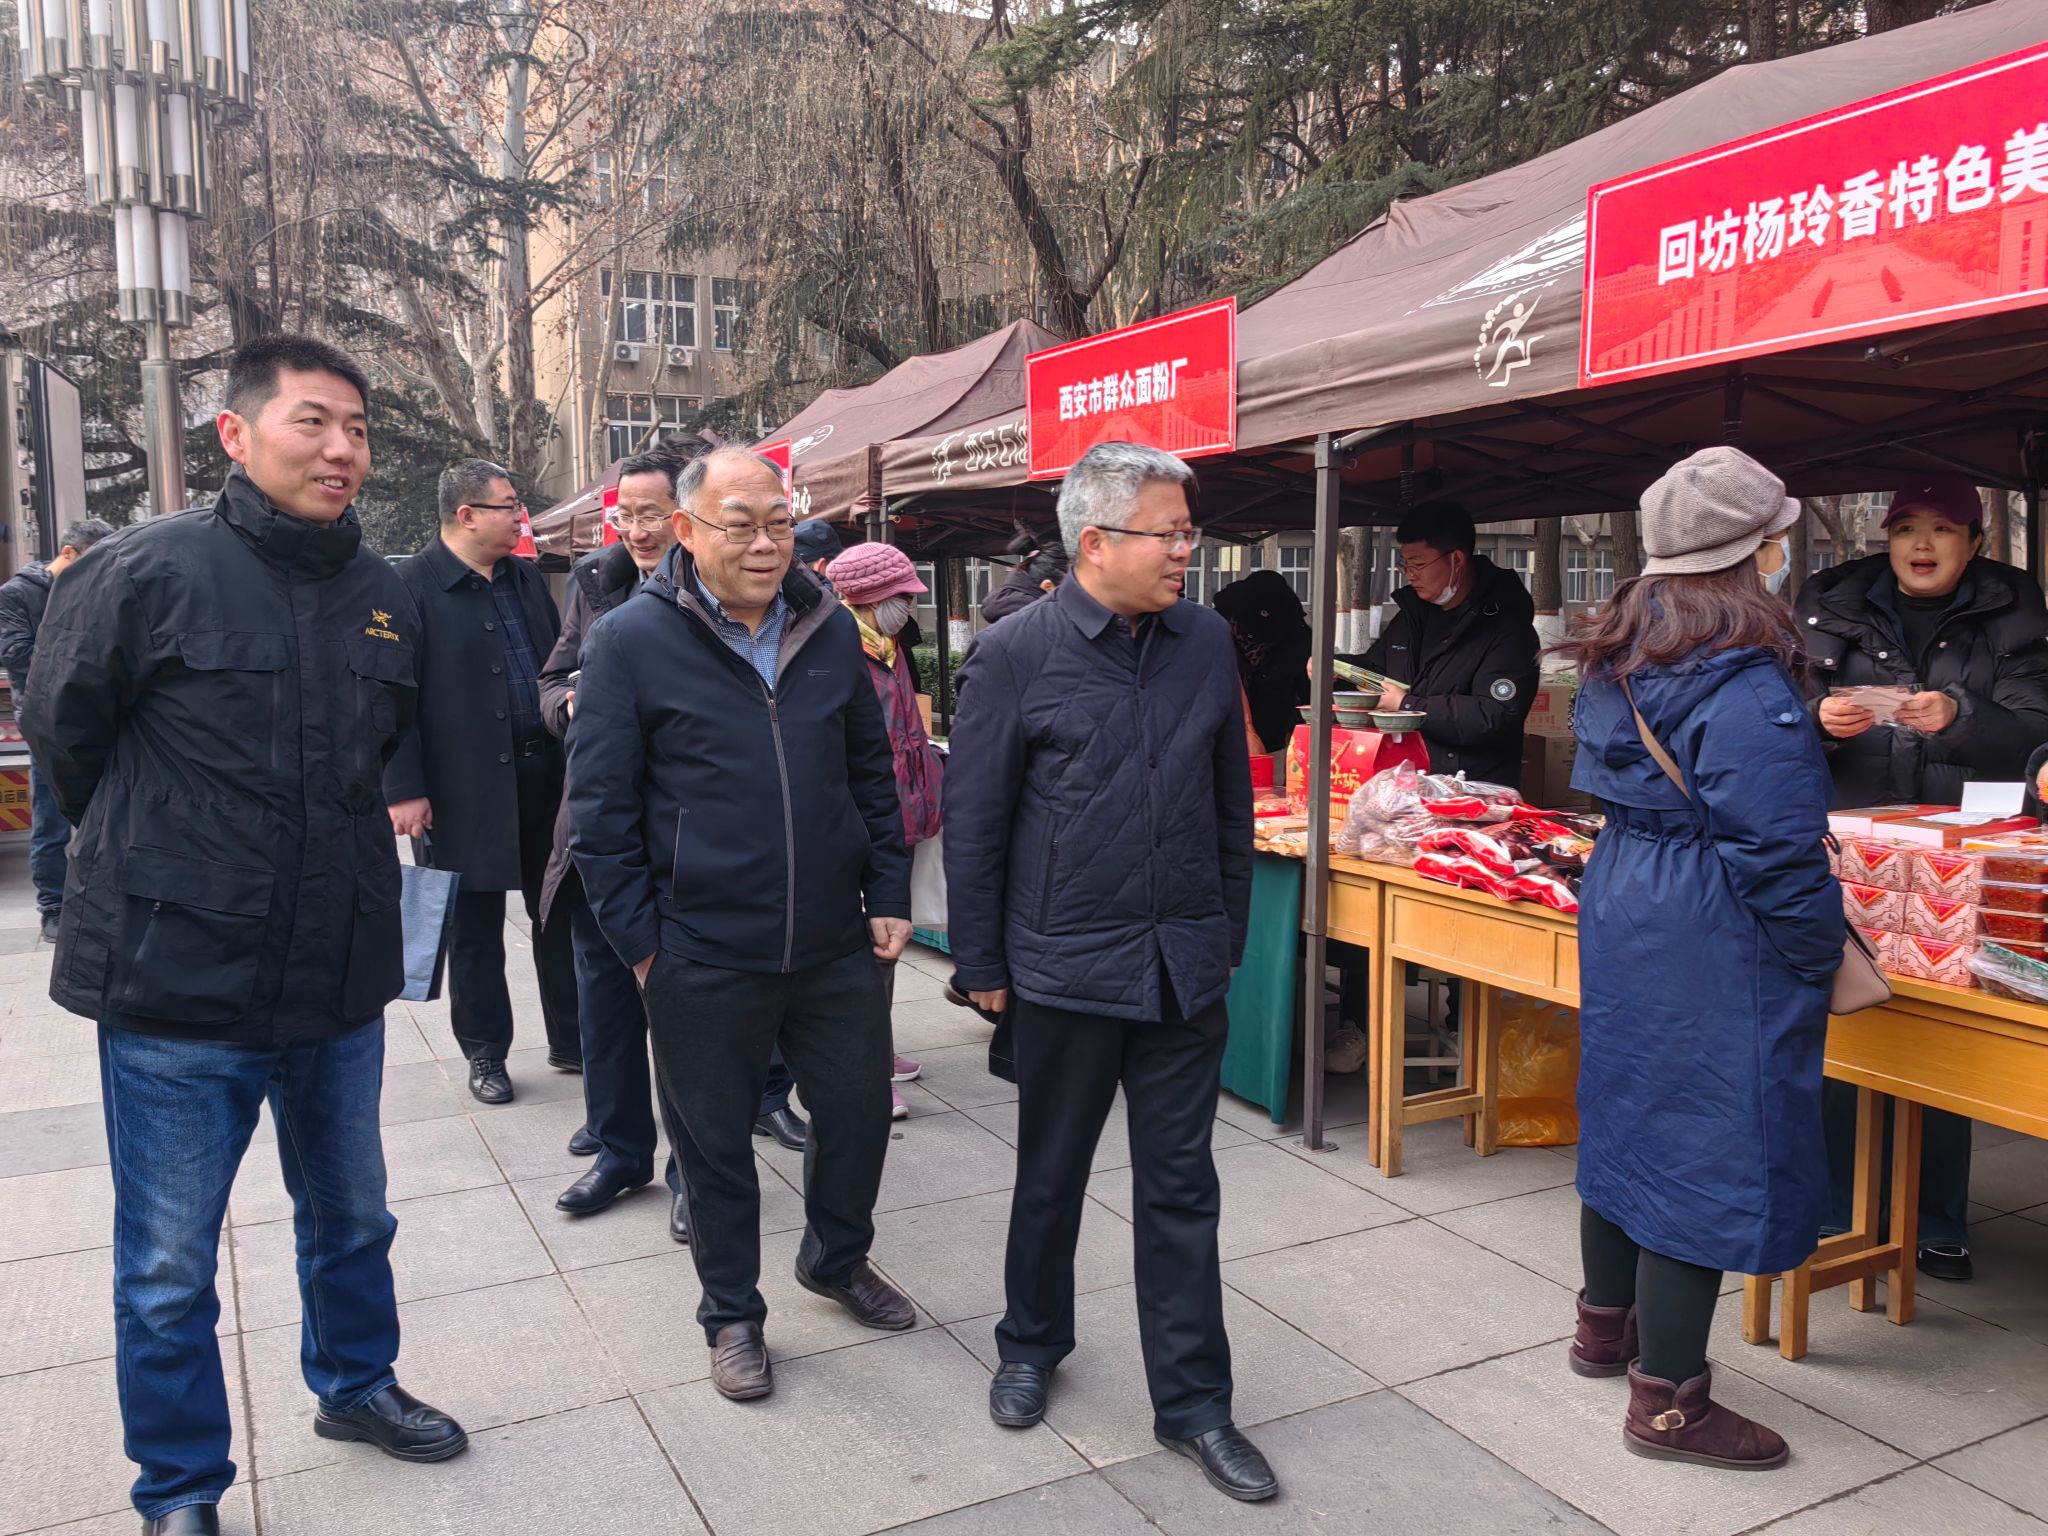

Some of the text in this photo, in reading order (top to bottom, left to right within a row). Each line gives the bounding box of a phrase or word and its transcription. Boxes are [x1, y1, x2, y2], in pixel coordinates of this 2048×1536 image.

[1657, 123, 2048, 285] 回坊杨玲香特色美
[1058, 357, 1188, 421] 西安市群众面粉厂
